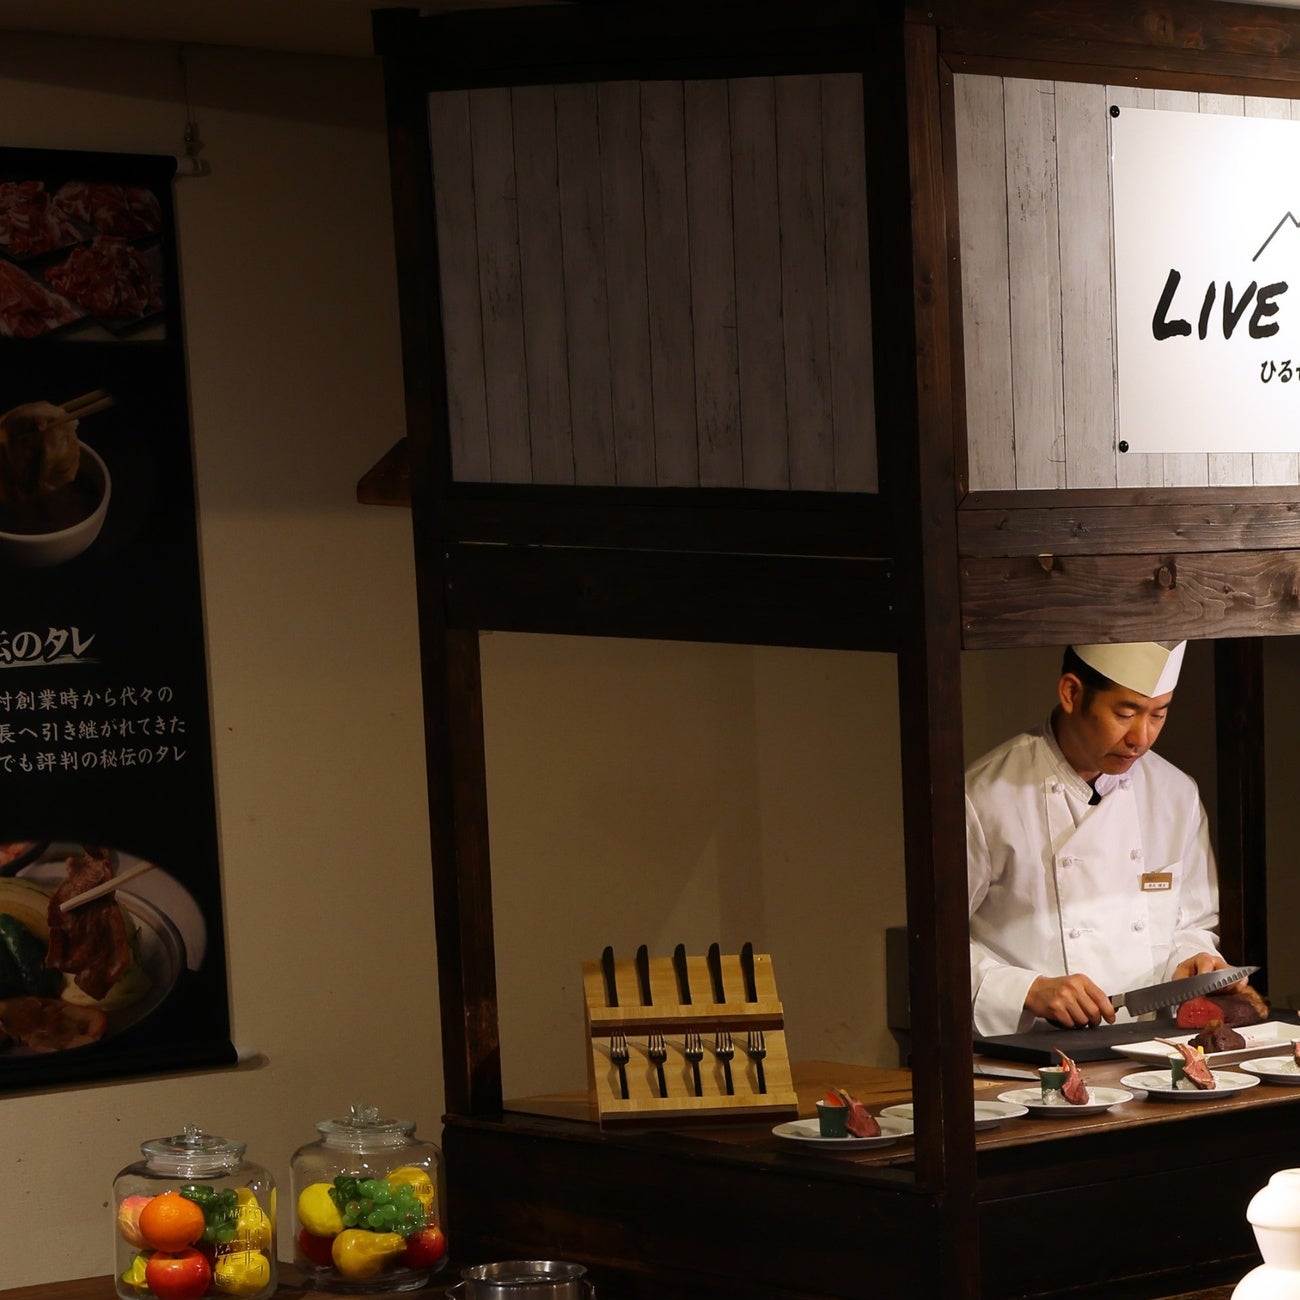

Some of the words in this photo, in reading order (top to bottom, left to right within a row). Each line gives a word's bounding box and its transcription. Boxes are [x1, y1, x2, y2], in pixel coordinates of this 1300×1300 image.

[1152, 268, 1289, 341] LIVE
[0, 746, 186, 773] でも評判の秘伝のタレ
